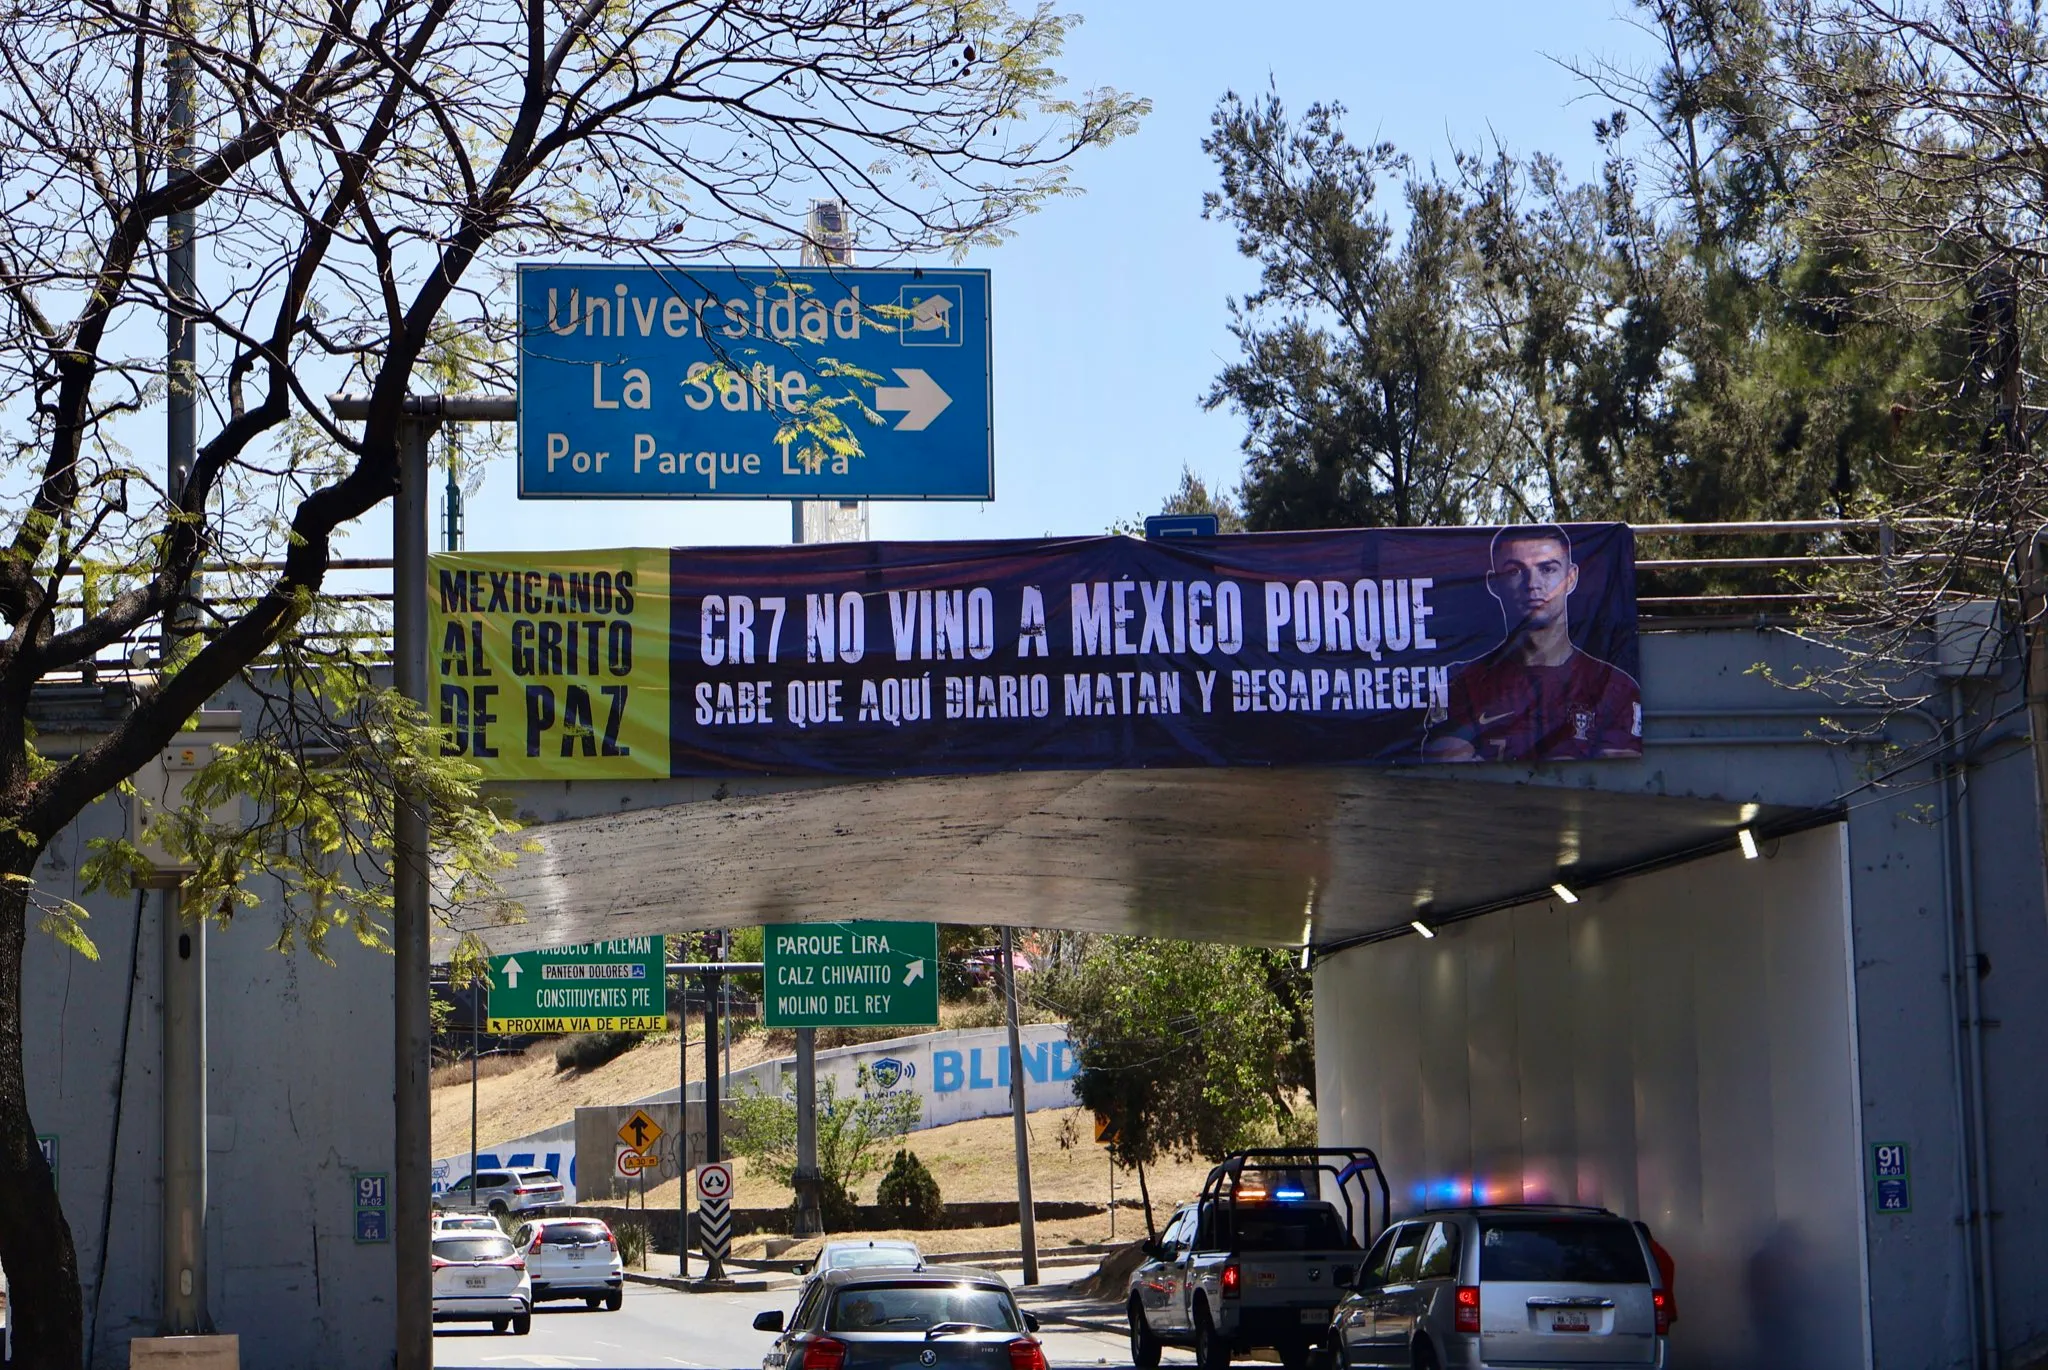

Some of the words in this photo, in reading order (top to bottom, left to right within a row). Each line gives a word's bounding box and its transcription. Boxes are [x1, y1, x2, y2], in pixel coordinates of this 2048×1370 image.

[547, 283, 861, 340] Universidad
[593, 362, 651, 410] La
[685, 361, 808, 411] Salle
[548, 433, 609, 473] Por
[634, 433, 761, 490] Parque
[439, 569, 634, 615] MEXICANOS
[700, 594, 786, 666] CR7
[806, 591, 865, 664] NO
[888, 587, 994, 661] VINO
[1018, 585, 1049, 658] A
[1071, 574, 1243, 657] MÉXICO
[1265, 577, 1437, 661] PORQUE
[441, 620, 491, 677] AL
[512, 619, 632, 677] GRITO
[695, 680, 773, 725] SABE
[787, 679, 843, 728] QUE
[858, 671, 931, 727] AQUÍ
[945, 673, 1049, 719] DIARIO
[1064, 671, 1181, 716] MATAN
[1198, 670, 1215, 713] Y
[1232, 666, 1449, 713] DESAPARECEN
[440, 684, 499, 758] DE
[526, 684, 630, 758] PAZ
[607, 936, 651, 954] ALEMAN
[777, 936, 843, 955] PARQUE
[852, 936, 890, 953] LIRA
[546, 965, 585, 978] PANTEON
[589, 965, 629, 978] DOLORES
[778, 966, 814, 985] CALZ
[822, 965, 891, 984] CHIVATITO
[536, 988, 627, 1008] CONSTITUYENTES
[632, 988, 650, 1007] PTE
[778, 996, 828, 1014] MOLINO
[835, 996, 859, 1014] DEL
[866, 995, 891, 1013] REY
[507, 1018, 564, 1032] PROXIMA
[570, 1018, 591, 1031] VIA
[597, 1017, 613, 1030] DE
[620, 1016, 661, 1030] PEAJE
[1878, 1146, 1900, 1167] 91
[360, 1178, 381, 1198] 91
